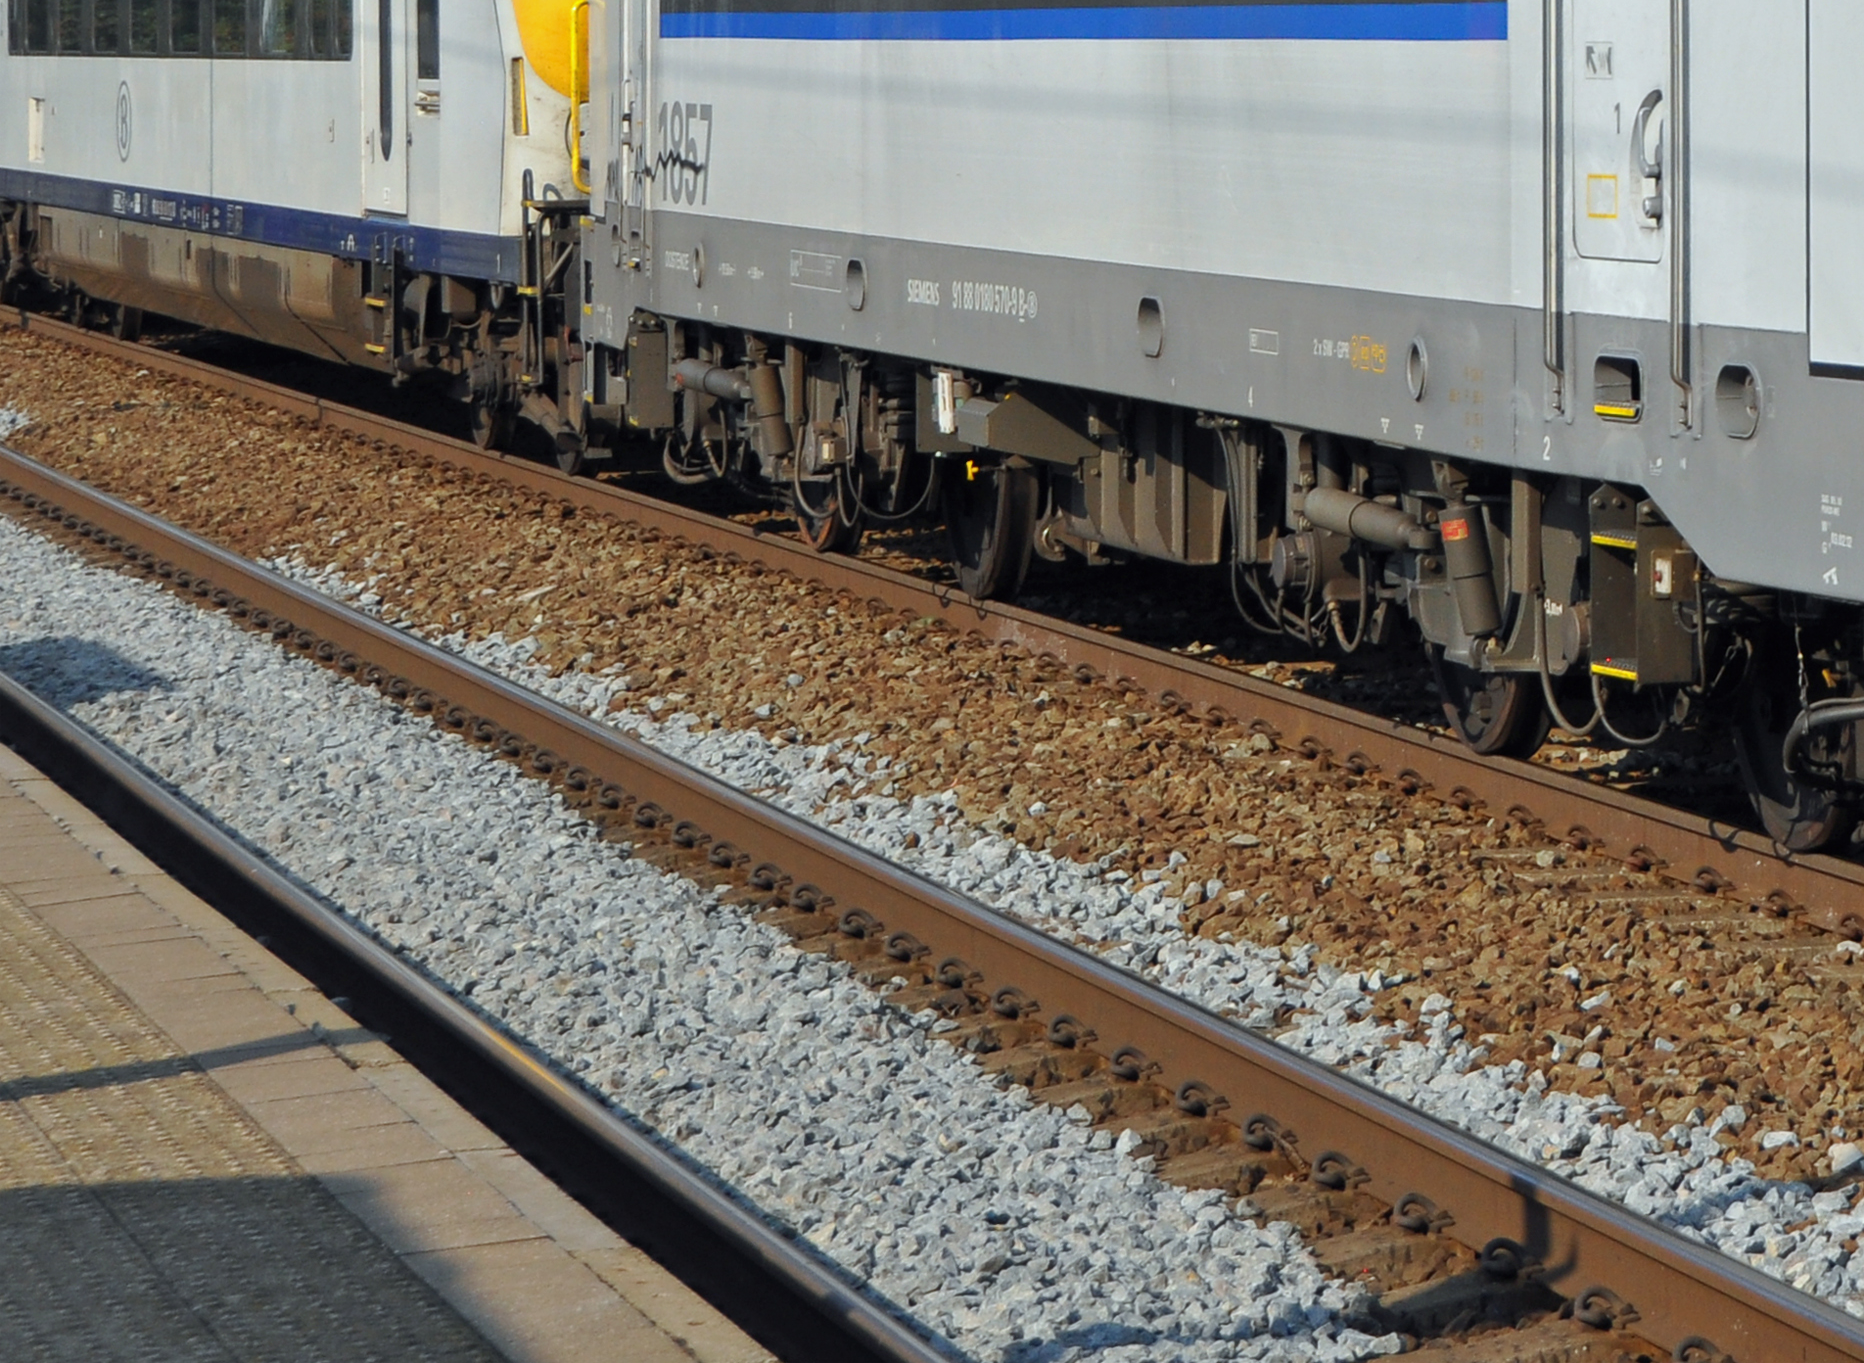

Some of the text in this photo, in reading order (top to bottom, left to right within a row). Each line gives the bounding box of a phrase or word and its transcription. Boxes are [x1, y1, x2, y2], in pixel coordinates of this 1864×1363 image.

[657, 100, 713, 206] 1857
[907, 279, 940, 307] SIEMENS
[1542, 435, 1551, 461] 2
